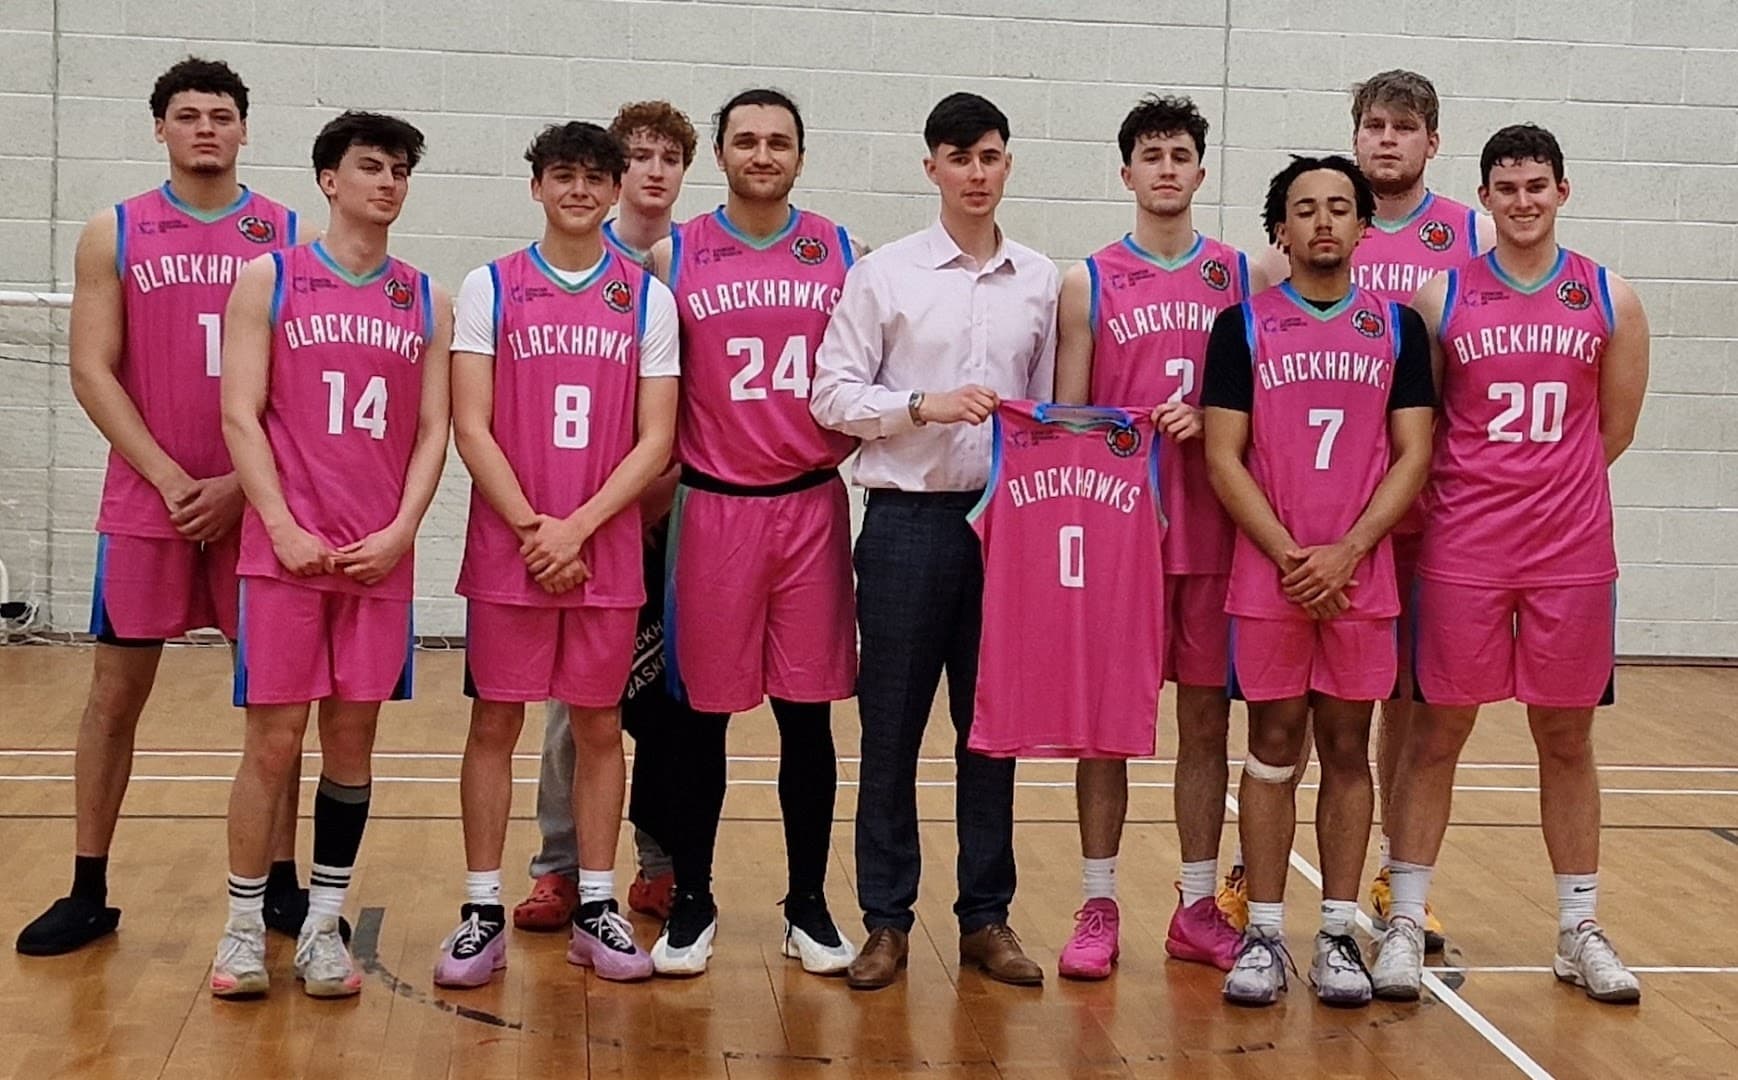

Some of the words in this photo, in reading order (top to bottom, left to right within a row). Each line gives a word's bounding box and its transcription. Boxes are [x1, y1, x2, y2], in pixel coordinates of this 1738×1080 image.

[688, 279, 841, 321] BLACKHAWKS
[284, 313, 423, 364] BLACKHAWKS
[726, 335, 811, 401] 24
[1453, 324, 1601, 365] BLACKHAWKS
[1258, 351, 1390, 391] BLACKHAWK
[322, 371, 389, 440] 14
[553, 384, 591, 449] 8
[1487, 381, 1568, 443] 20
[1308, 408, 1344, 470] 7
[1008, 466, 1141, 514] BLACKHAWKS
[1059, 525, 1084, 588] 0
